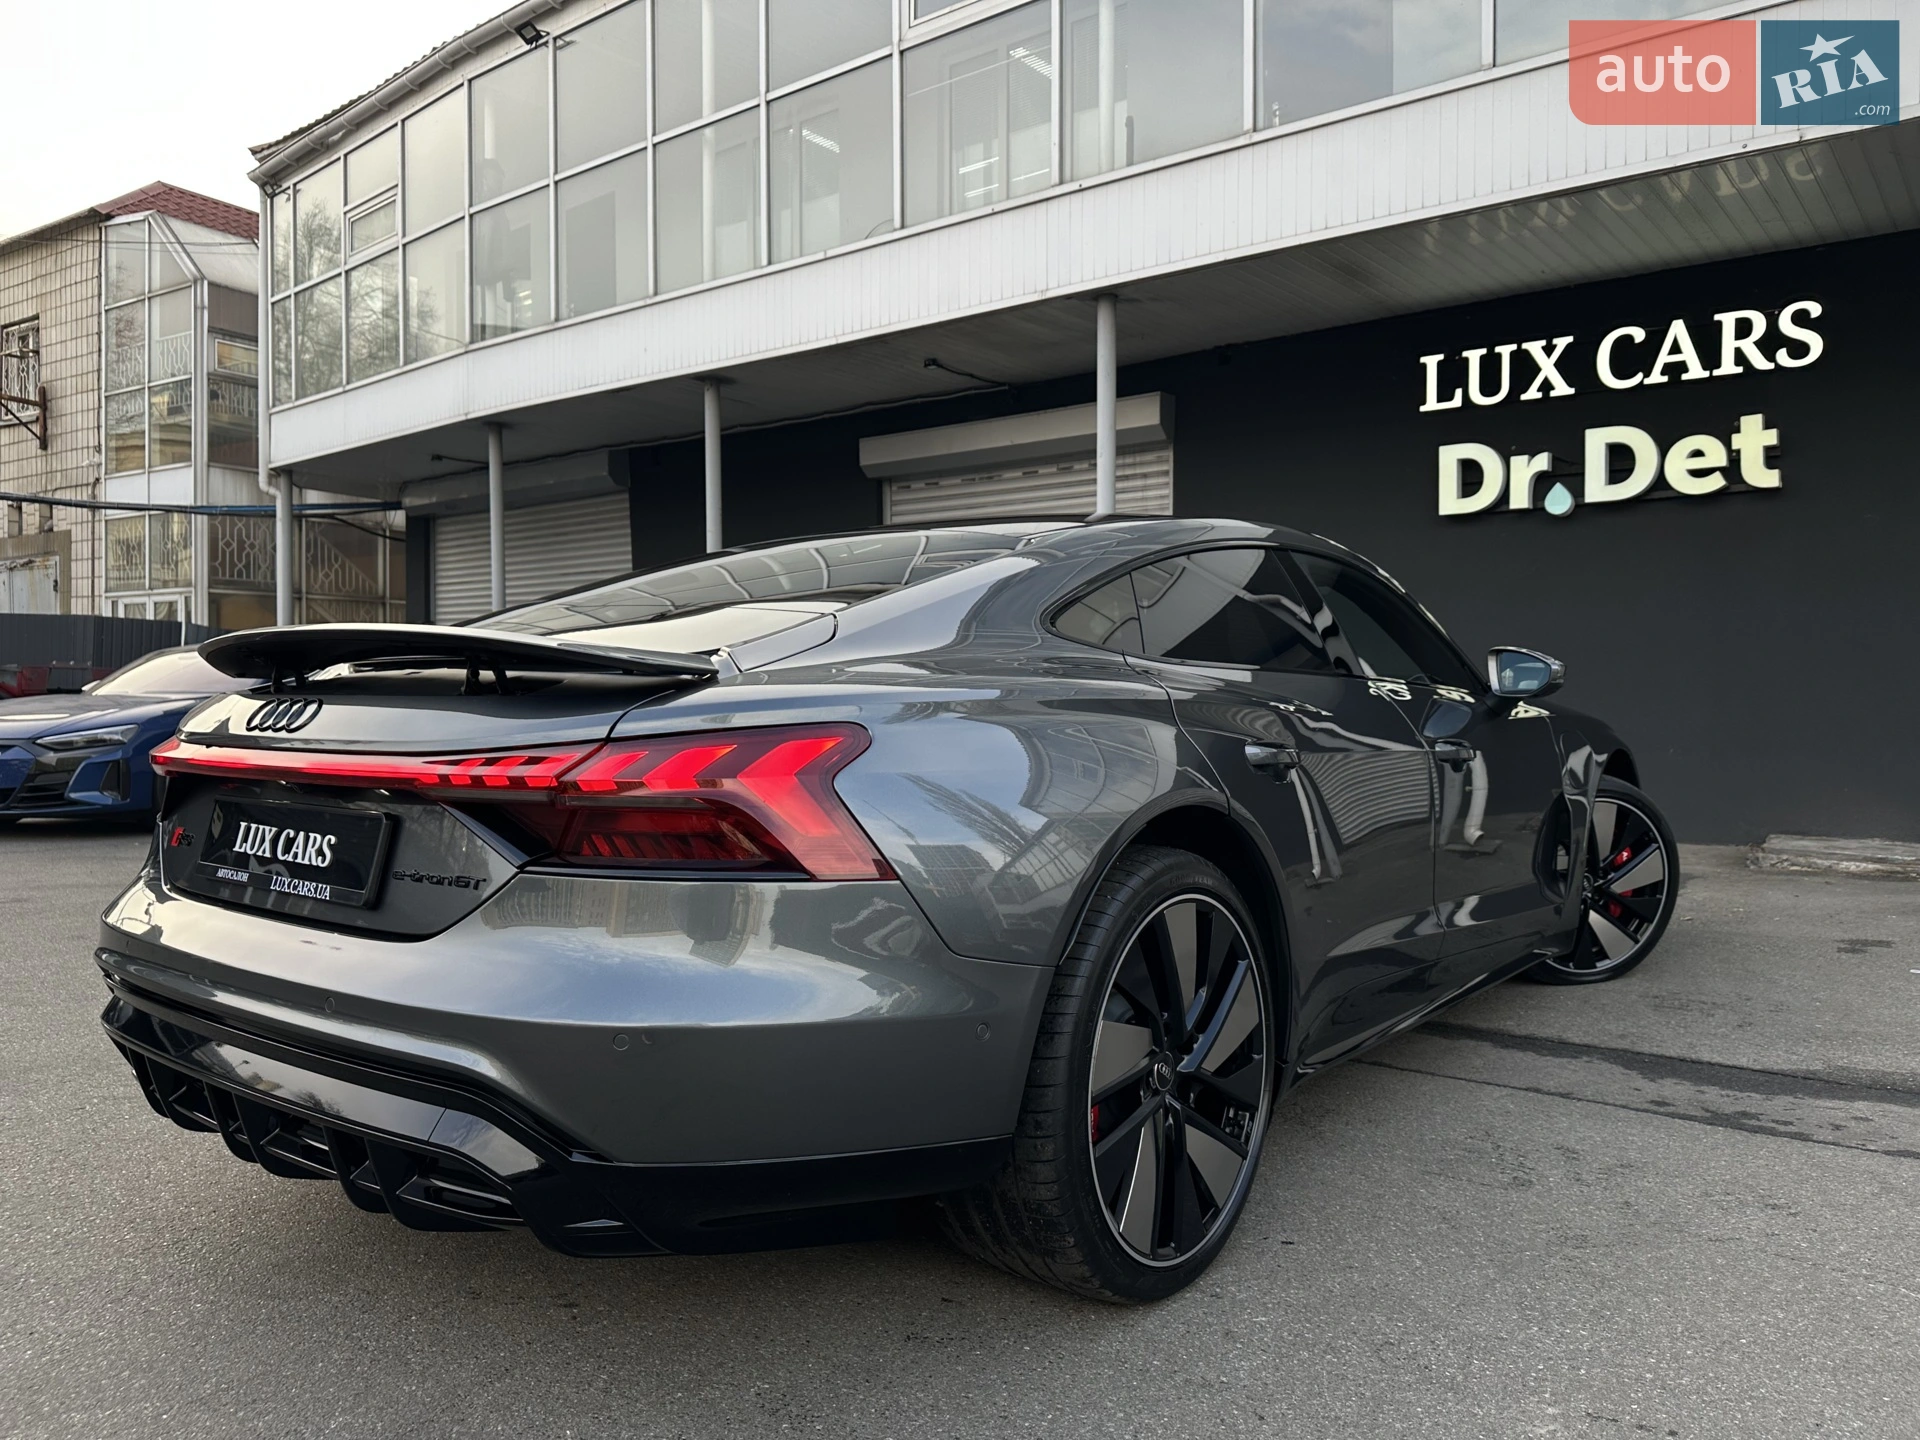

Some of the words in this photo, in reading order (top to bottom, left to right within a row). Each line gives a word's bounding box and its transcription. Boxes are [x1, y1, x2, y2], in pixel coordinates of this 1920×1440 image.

[1419, 335, 1576, 412] LUX
[1596, 300, 1824, 389] CARS
[233, 821, 275, 858] LUX
[276, 828, 337, 868] CARS
[216, 868, 249, 882] АВТОСАЛОН
